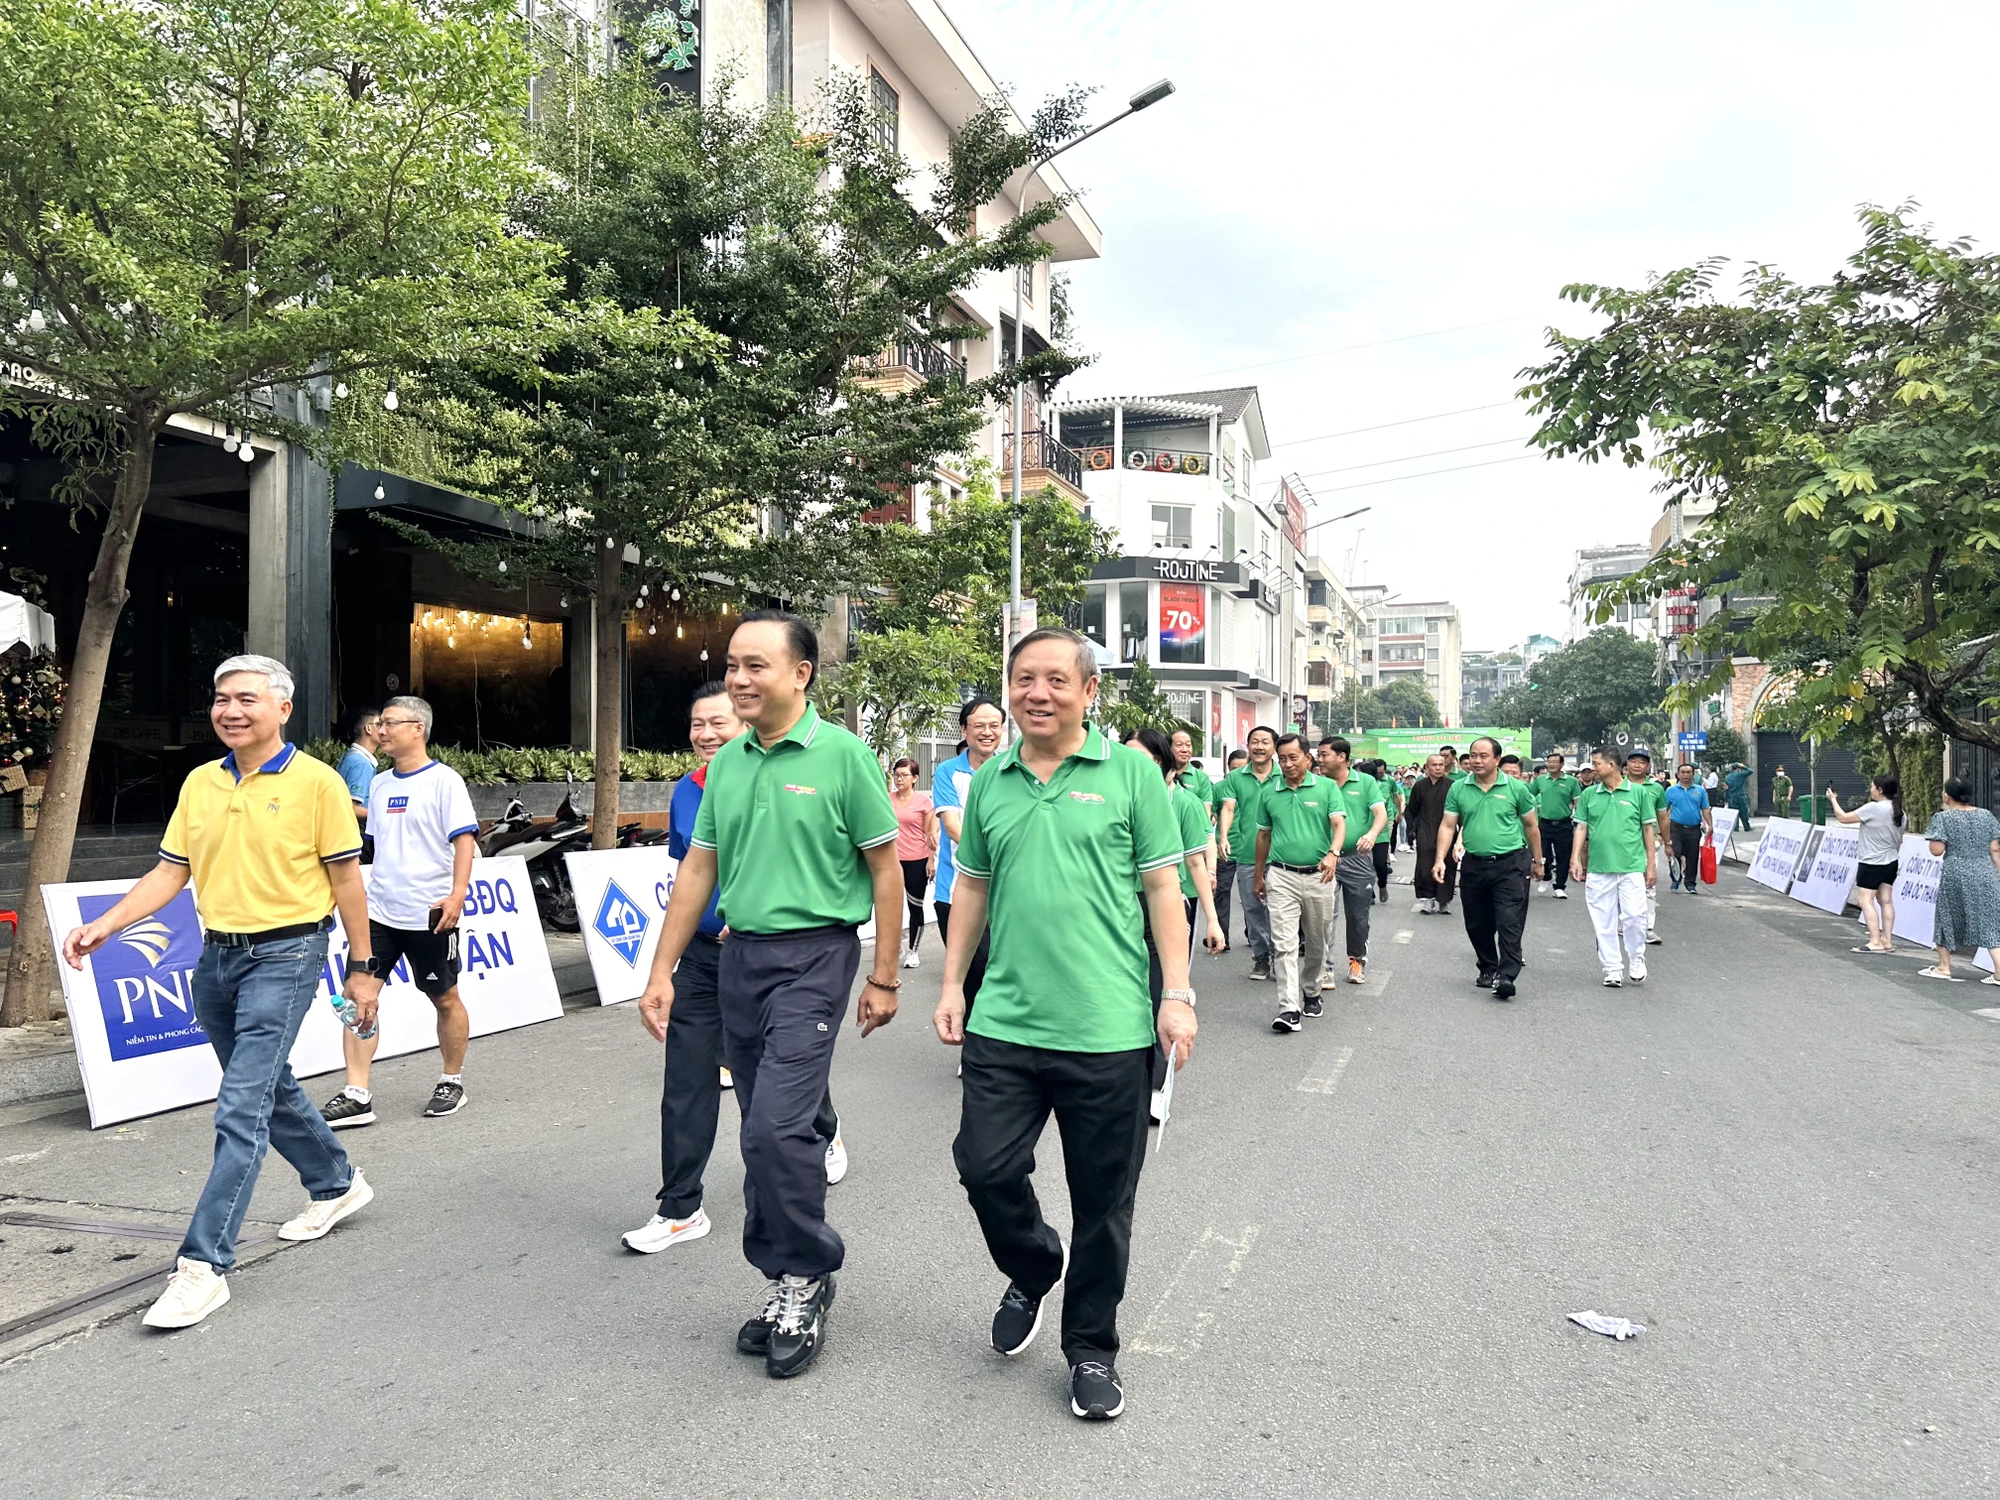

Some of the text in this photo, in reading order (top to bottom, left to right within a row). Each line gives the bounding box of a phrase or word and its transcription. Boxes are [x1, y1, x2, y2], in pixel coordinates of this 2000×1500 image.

[1154, 559, 1223, 582] ROUTINE
[1906, 853, 1925, 875] CÔNG
[126, 1033, 144, 1046] NIỀM
[145, 1034, 157, 1043] TIN
[158, 1032, 164, 1041] &
[164, 1028, 190, 1040] PHONG
